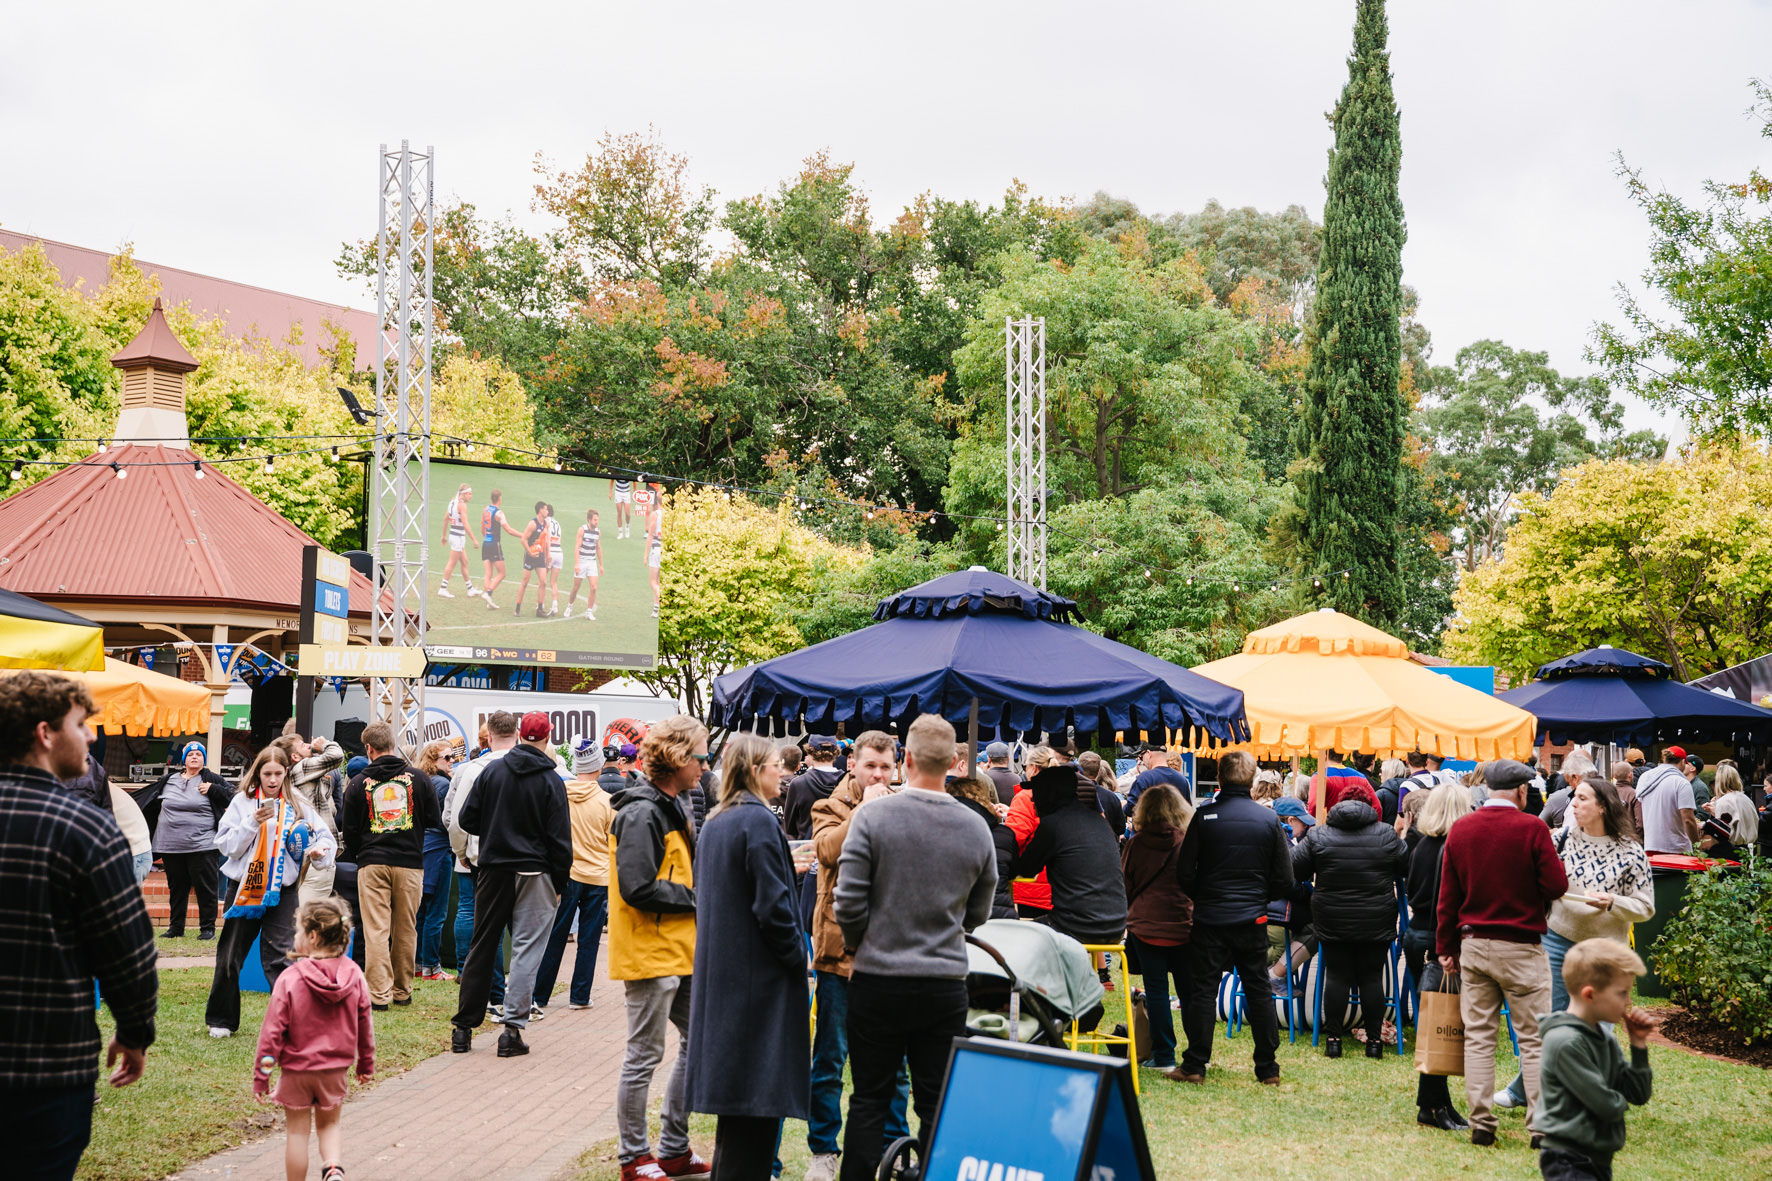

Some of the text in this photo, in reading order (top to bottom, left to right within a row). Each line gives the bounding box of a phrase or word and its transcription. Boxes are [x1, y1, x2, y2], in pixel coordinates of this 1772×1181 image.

[636, 492, 649, 501] FOX
[324, 588, 341, 612] TOILETS
[323, 650, 402, 672] PLAY ZONE
[475, 649, 488, 657] 96
[502, 650, 518, 658] WC
[540, 652, 552, 660] 62
[461, 676, 492, 689] OVA
[274, 848, 286, 889] FOOTY
